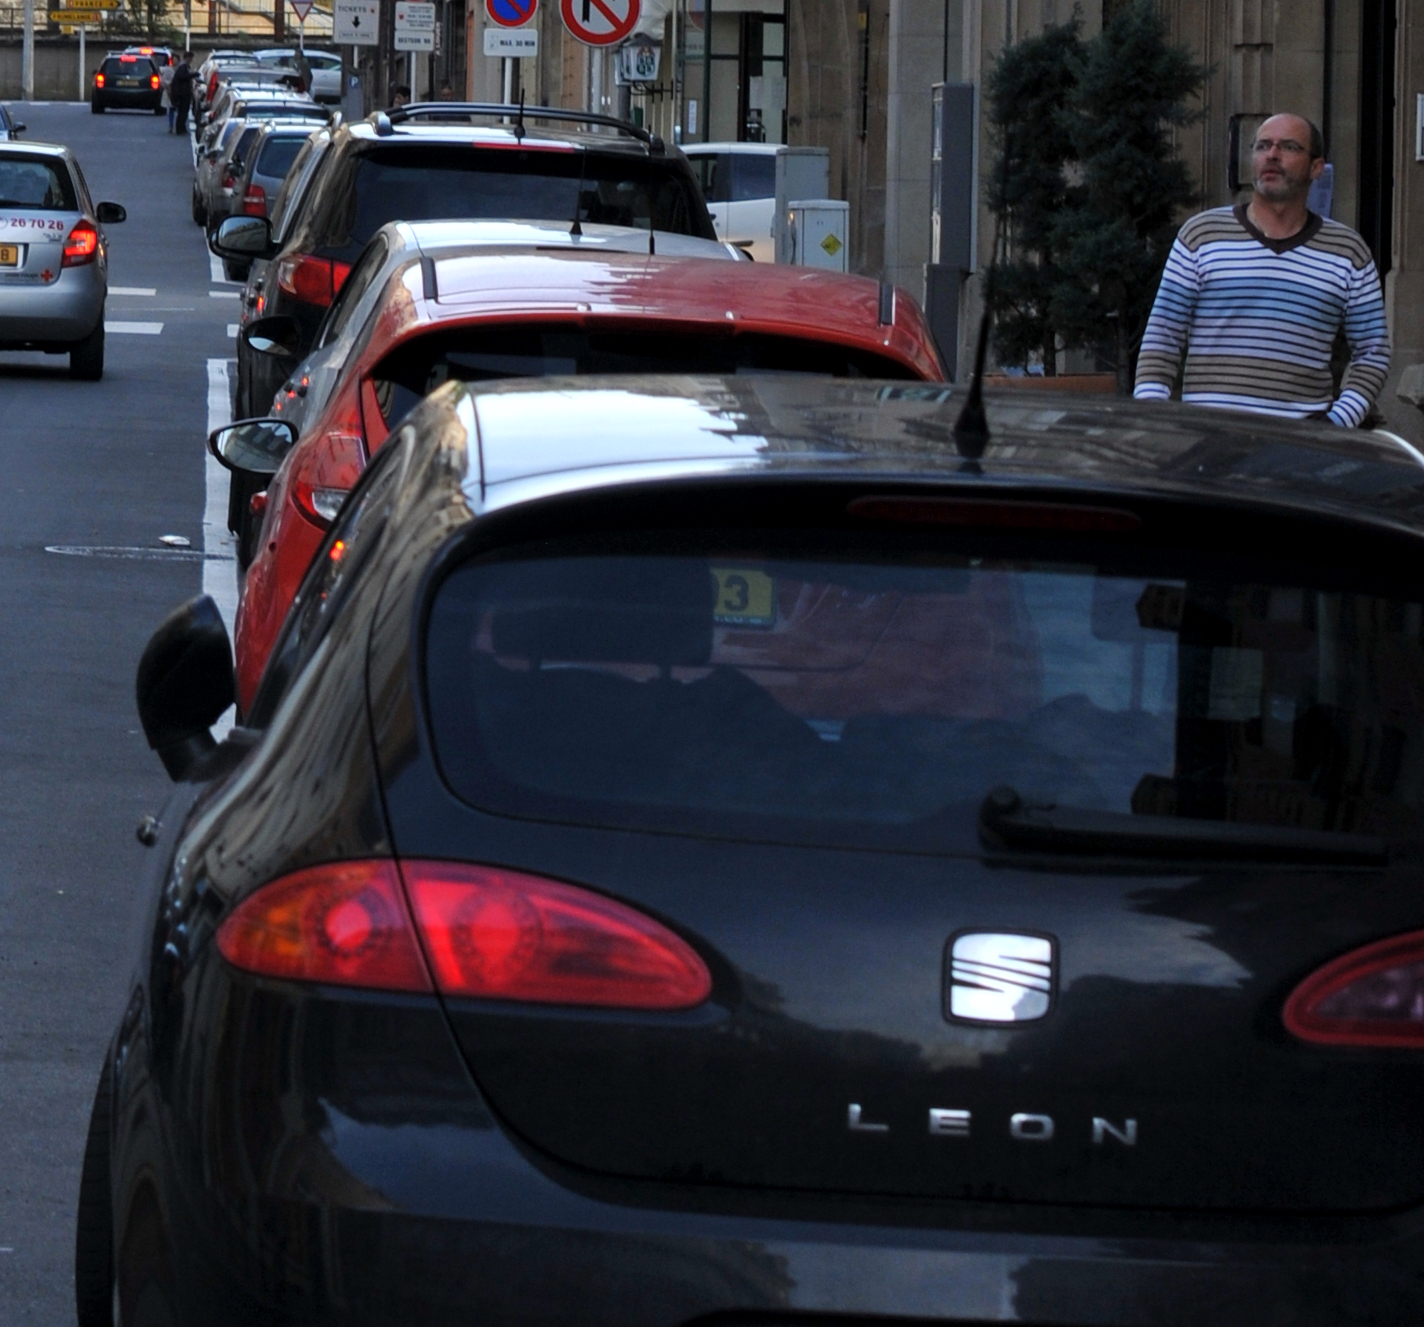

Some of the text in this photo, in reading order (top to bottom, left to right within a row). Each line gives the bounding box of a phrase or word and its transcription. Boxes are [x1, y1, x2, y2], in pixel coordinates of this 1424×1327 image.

[338, 5, 367, 13] TICKETS
[351, 77, 359, 87] P
[10, 218, 64, 231] 26 70 26
[715, 574, 749, 611] 3
[848, 1102, 1138, 1146] LEON
